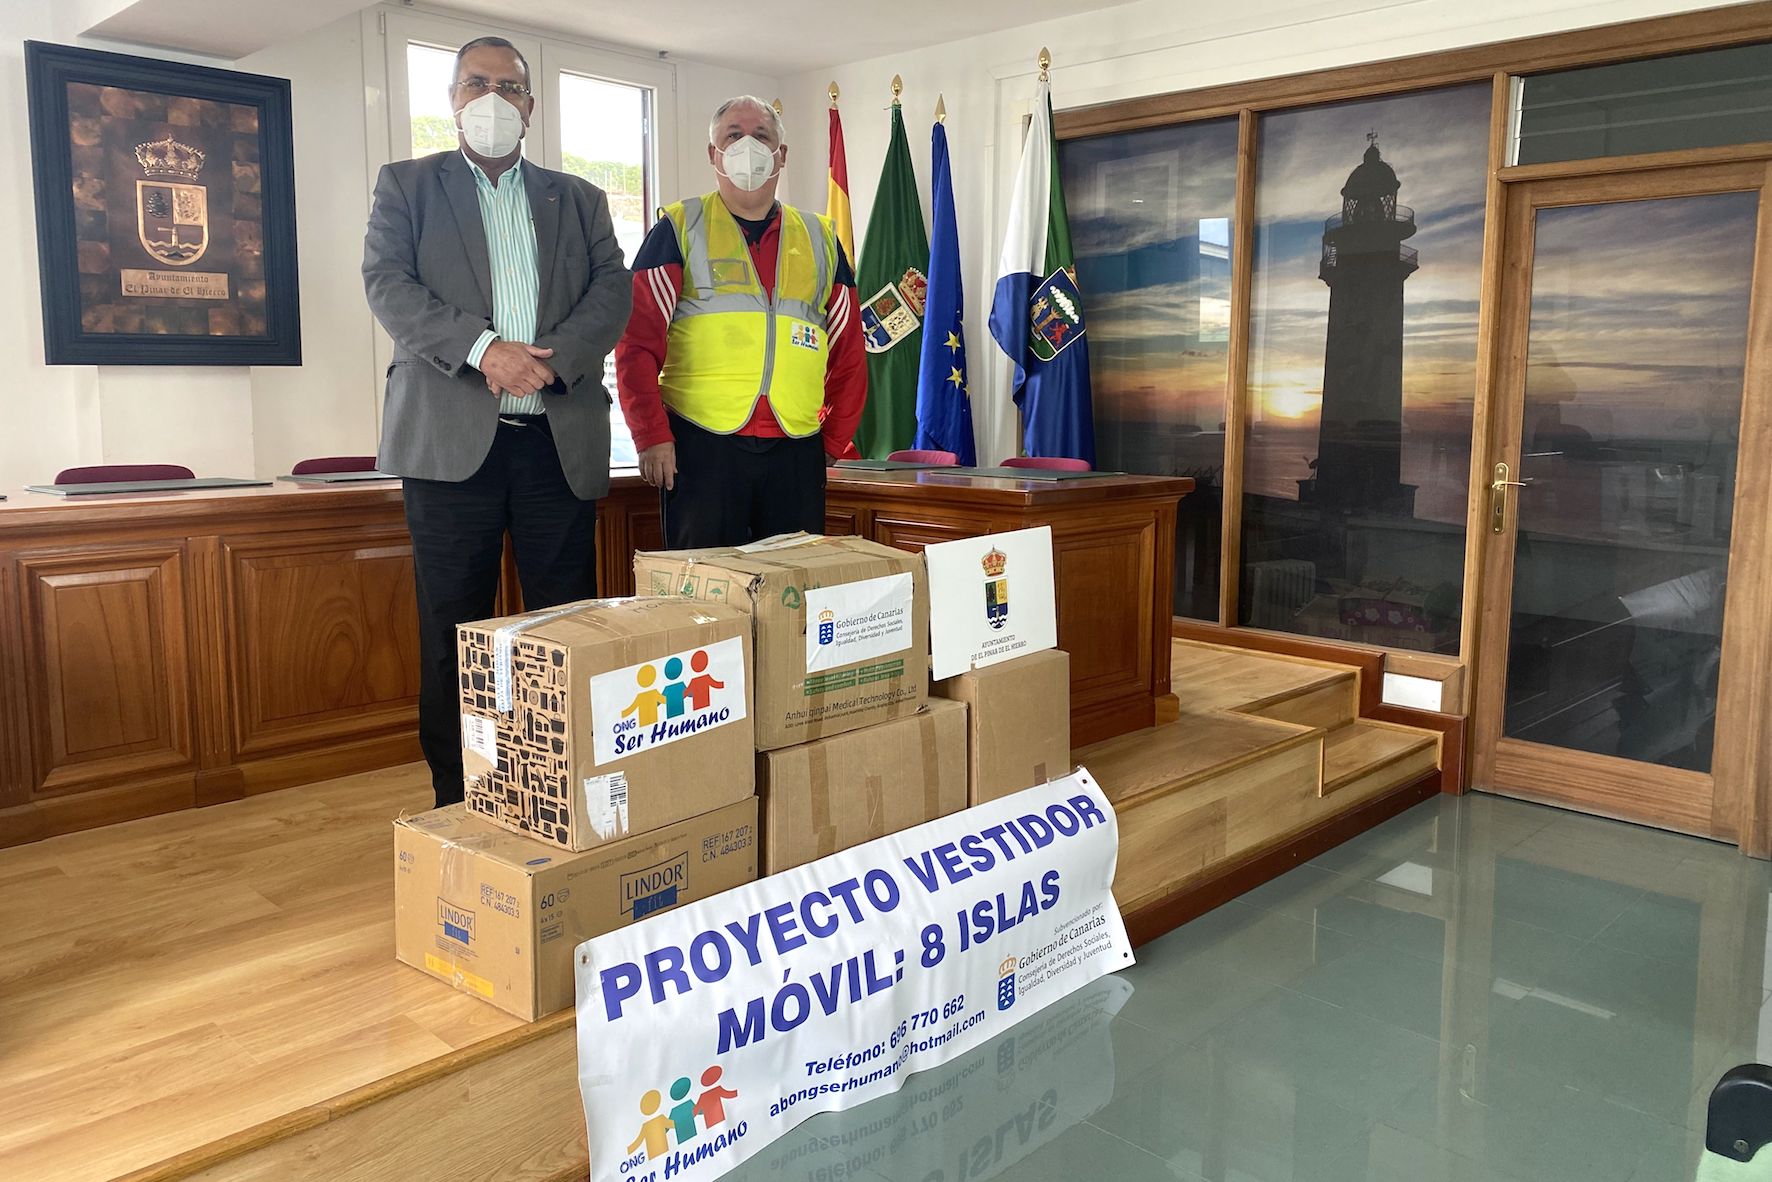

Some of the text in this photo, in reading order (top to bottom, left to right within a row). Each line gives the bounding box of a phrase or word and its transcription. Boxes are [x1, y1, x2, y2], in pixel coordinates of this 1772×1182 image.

[125, 284, 226, 296] El Pinar de El Hierro
[148, 271, 209, 283] Ayuntamiento
[836, 607, 904, 629] Gobierno de Canarias
[785, 710, 808, 721] Anhui
[832, 698, 859, 711] Medical
[859, 690, 896, 705] Technology
[613, 717, 637, 735] ONG
[614, 705, 730, 755] Ser Humano
[703, 834, 721, 850] REF
[721, 830, 734, 843] 167
[735, 824, 748, 839] 207
[626, 863, 684, 900] LINDOR
[541, 893, 555, 910] 60
[600, 794, 1107, 1022] PROYECTO VESTIDOR
[440, 904, 473, 931] LINDOR
[1053, 908, 1092, 935] Subvencionado
[1018, 914, 1107, 970] Gobierno de Canarias
[1048, 956, 1056, 967] de
[1057, 942, 1084, 961] Derechos
[1084, 930, 1112, 949] Sociales,
[717, 869, 1061, 1056] MÓVIL: 8 ISLAS
[1018, 975, 1046, 997] Igualdad,
[1046, 957, 1077, 980] Diversidad
[1083, 940, 1113, 961] Juventud
[805, 1041, 886, 1077] Teléfono:
[911, 1007, 938, 1032] 770
[943, 994, 965, 1020] 662
[619, 1151, 646, 1174] ONG
[664, 1119, 748, 1181] Humano
